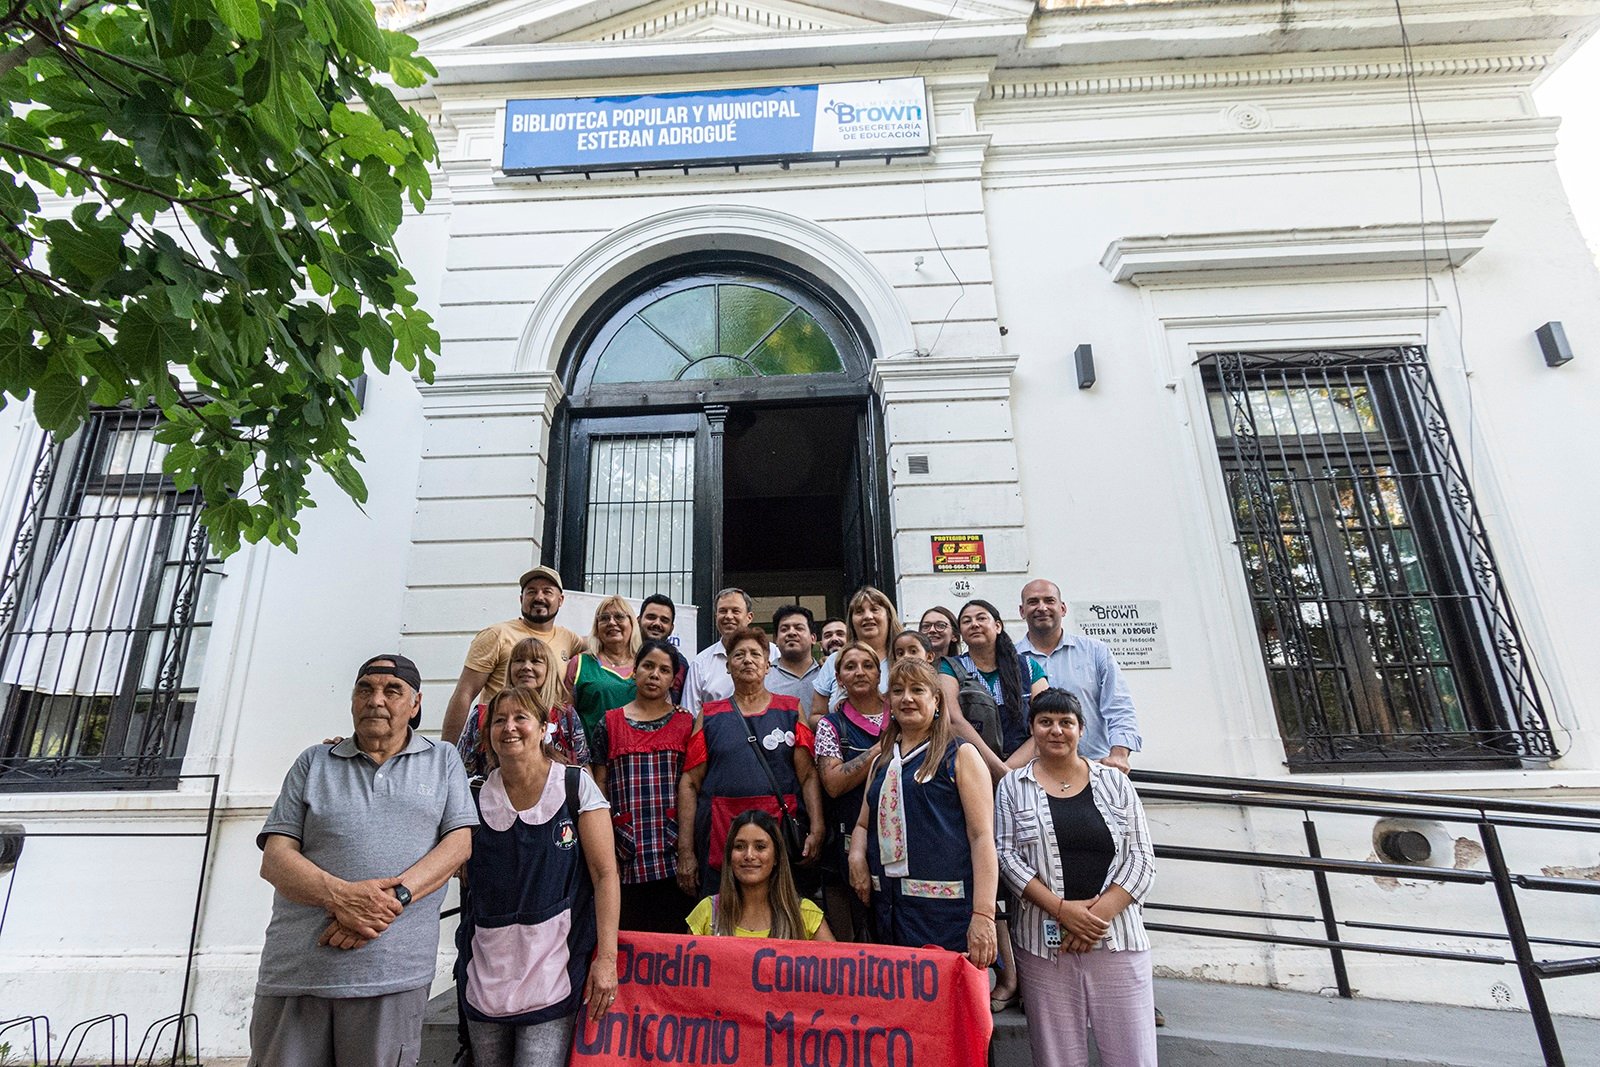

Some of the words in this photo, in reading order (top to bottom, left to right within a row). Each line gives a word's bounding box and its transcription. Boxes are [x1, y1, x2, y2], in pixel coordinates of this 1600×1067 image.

[511, 111, 608, 134] BIBLIOTECA
[611, 105, 688, 129] POPULAR
[692, 105, 705, 123] Y
[707, 99, 801, 123] MUNICIPAL
[837, 104, 922, 124] Brown
[576, 128, 655, 151] ESTEBAN
[657, 121, 738, 147] ADROGUÉ
[838, 122, 922, 133] SUBSECRETARÍA
[843, 132, 857, 141] DE
[860, 130, 921, 140] EDUCACIÓN
[955, 580, 970, 590] 974
[1097, 607, 1139, 620] Brown
[618, 940, 711, 988] Jardín
[752, 947, 939, 1003] Comunitario
[575, 1003, 740, 1065] Unicornio
